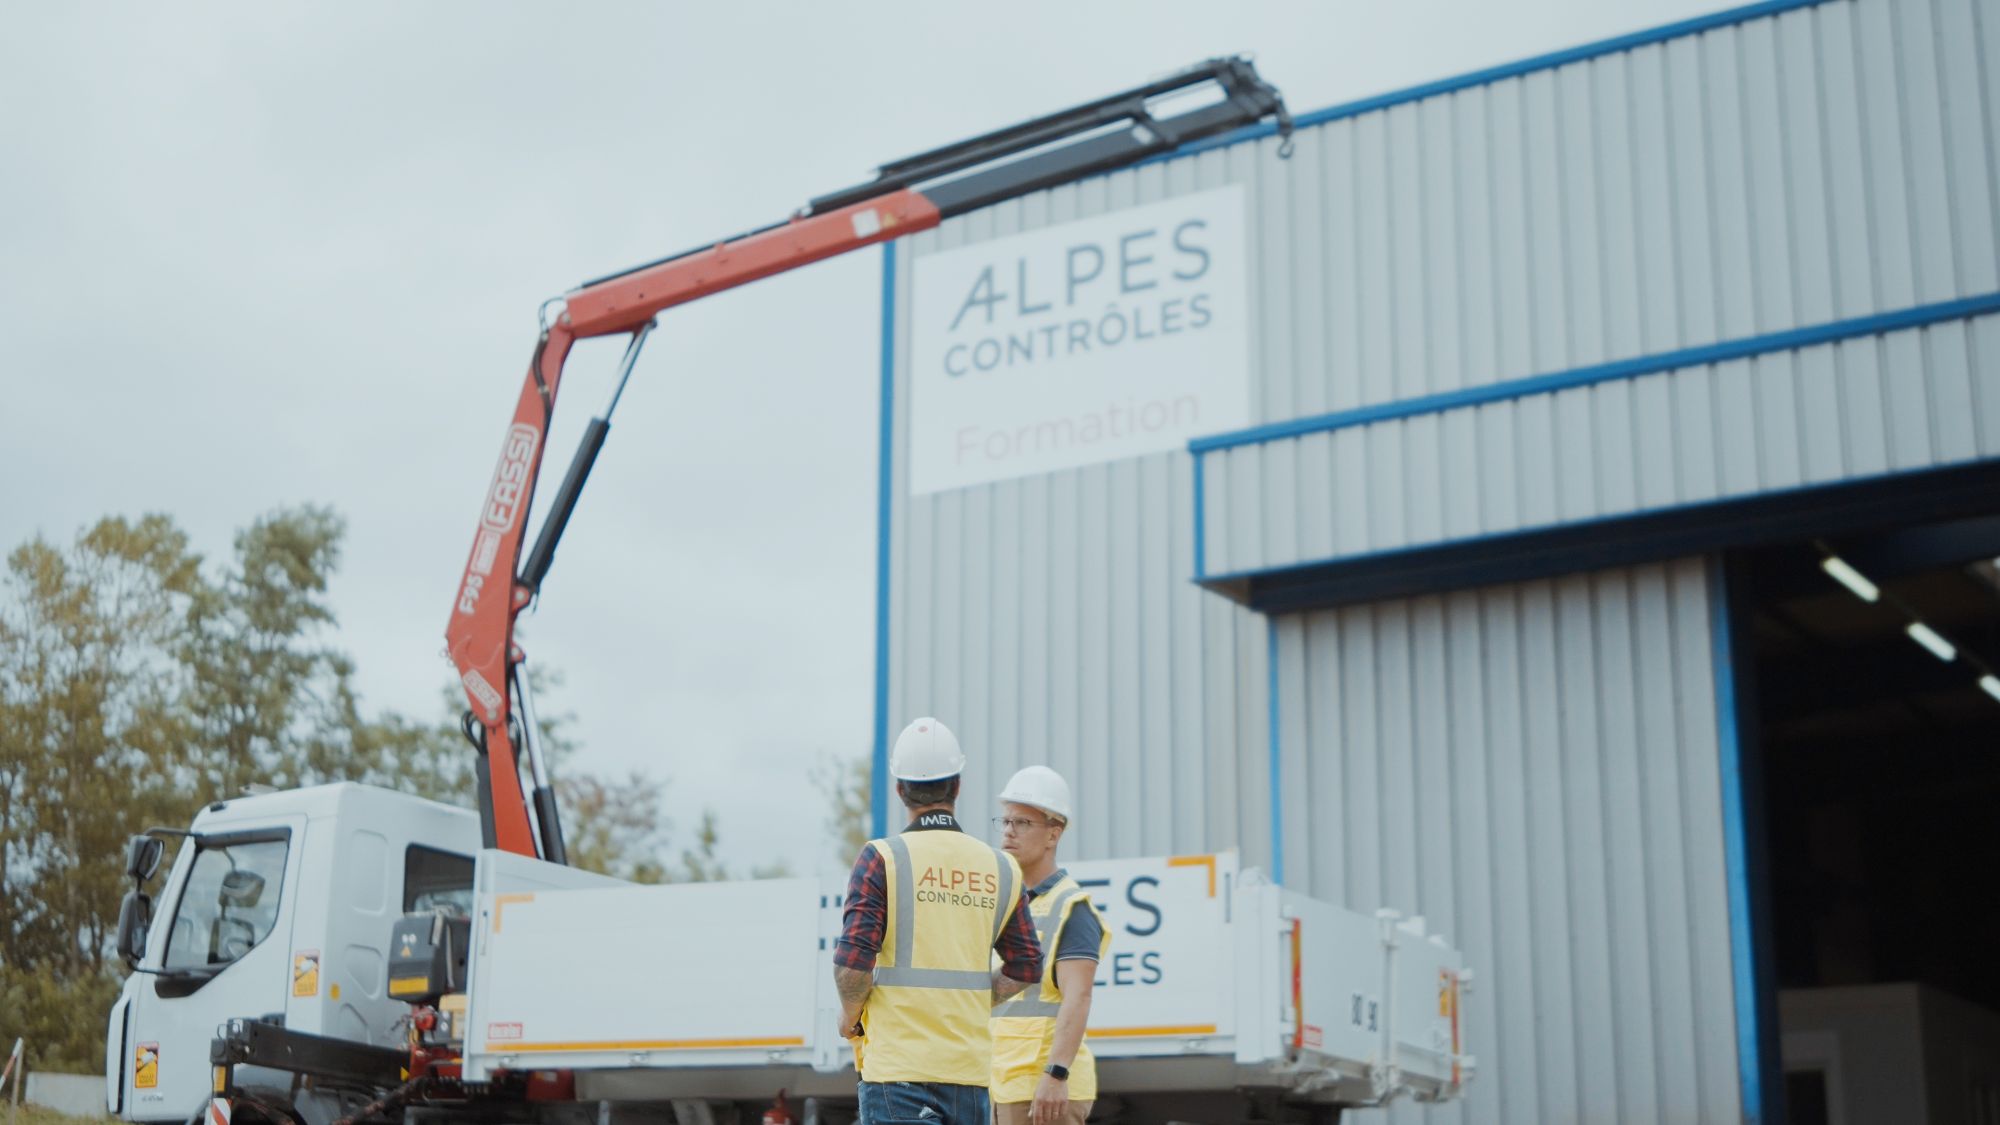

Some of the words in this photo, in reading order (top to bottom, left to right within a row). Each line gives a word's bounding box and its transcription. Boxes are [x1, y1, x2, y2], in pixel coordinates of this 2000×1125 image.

[947, 219, 1211, 332] ALPES
[943, 293, 1213, 378] CONTRÔLES
[954, 393, 1200, 467] Formation
[487, 430, 533, 525] FASSI
[916, 890, 996, 910] CONTRÔLES
[918, 866, 997, 894] ALPES
